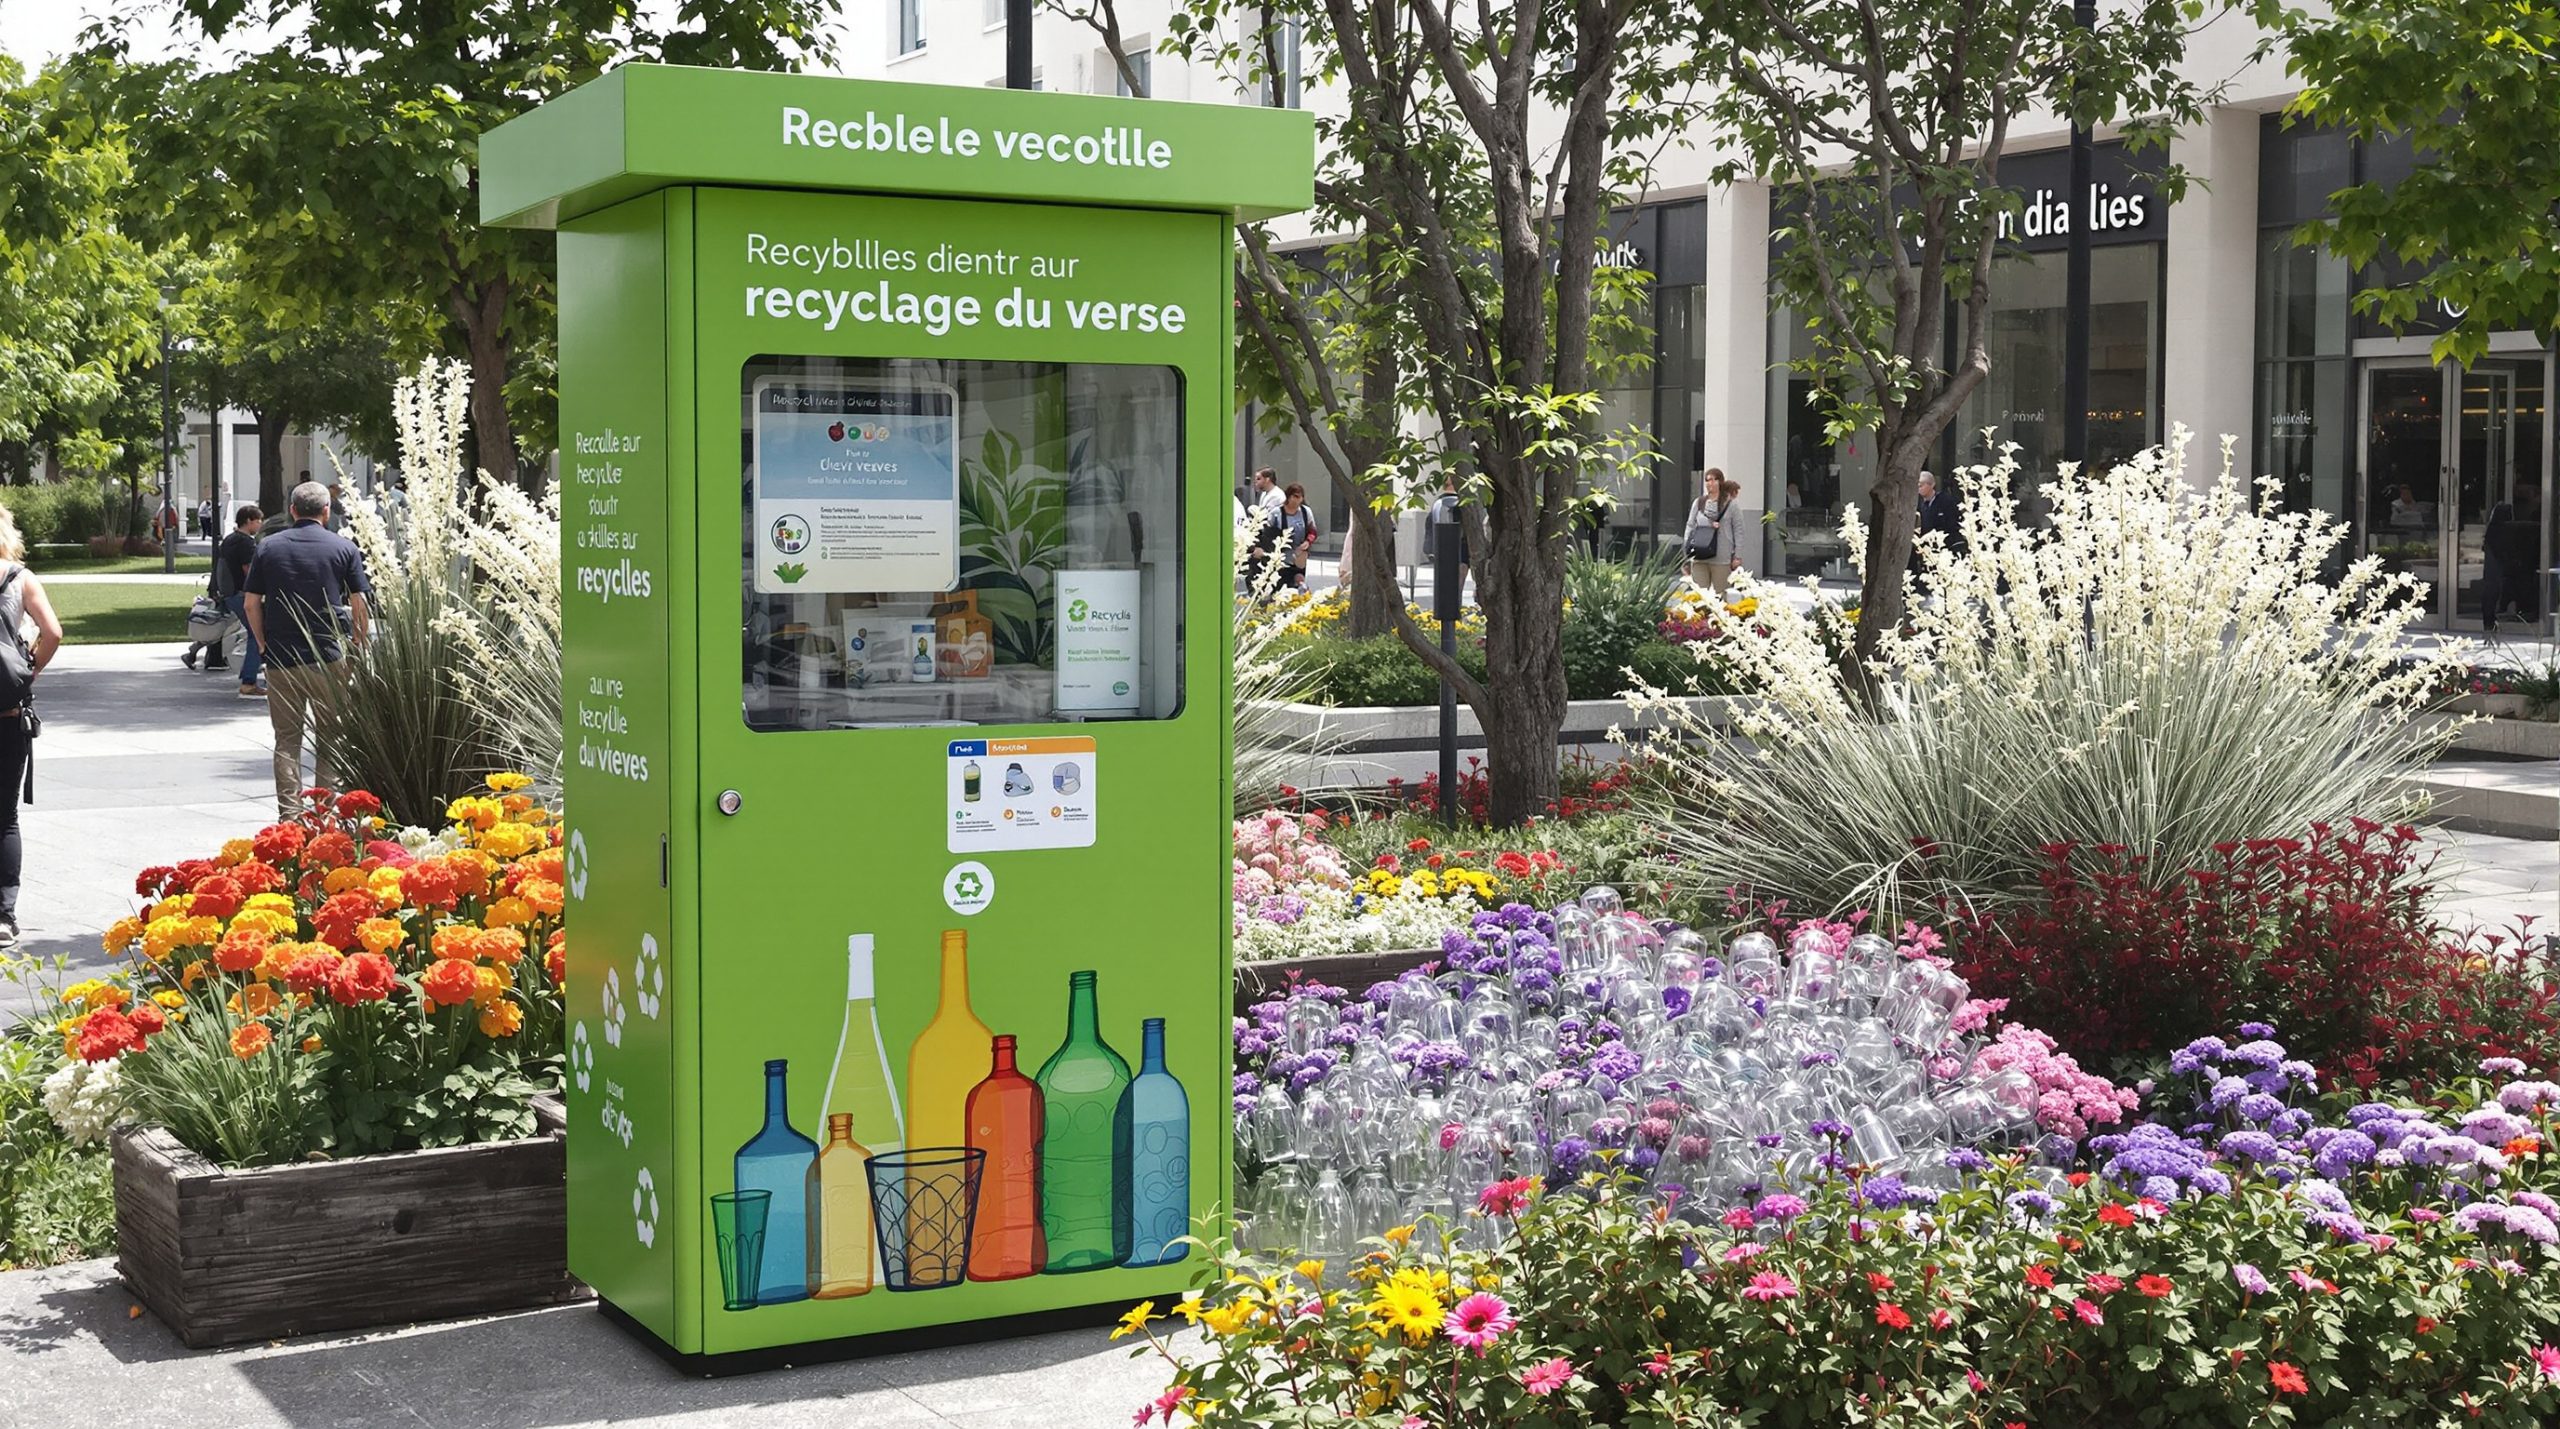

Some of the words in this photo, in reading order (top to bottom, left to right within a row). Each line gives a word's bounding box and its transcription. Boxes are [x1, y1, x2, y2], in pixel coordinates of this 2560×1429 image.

[782, 106, 980, 158] Recblele
[993, 126, 1172, 169] vecotlle
[746, 233, 917, 274] Recybllles
[927, 244, 1020, 275] dientr
[1030, 255, 1079, 278] aur
[745, 281, 981, 336] recyclage
[995, 287, 1051, 328] du
[1066, 300, 1186, 334] verse
